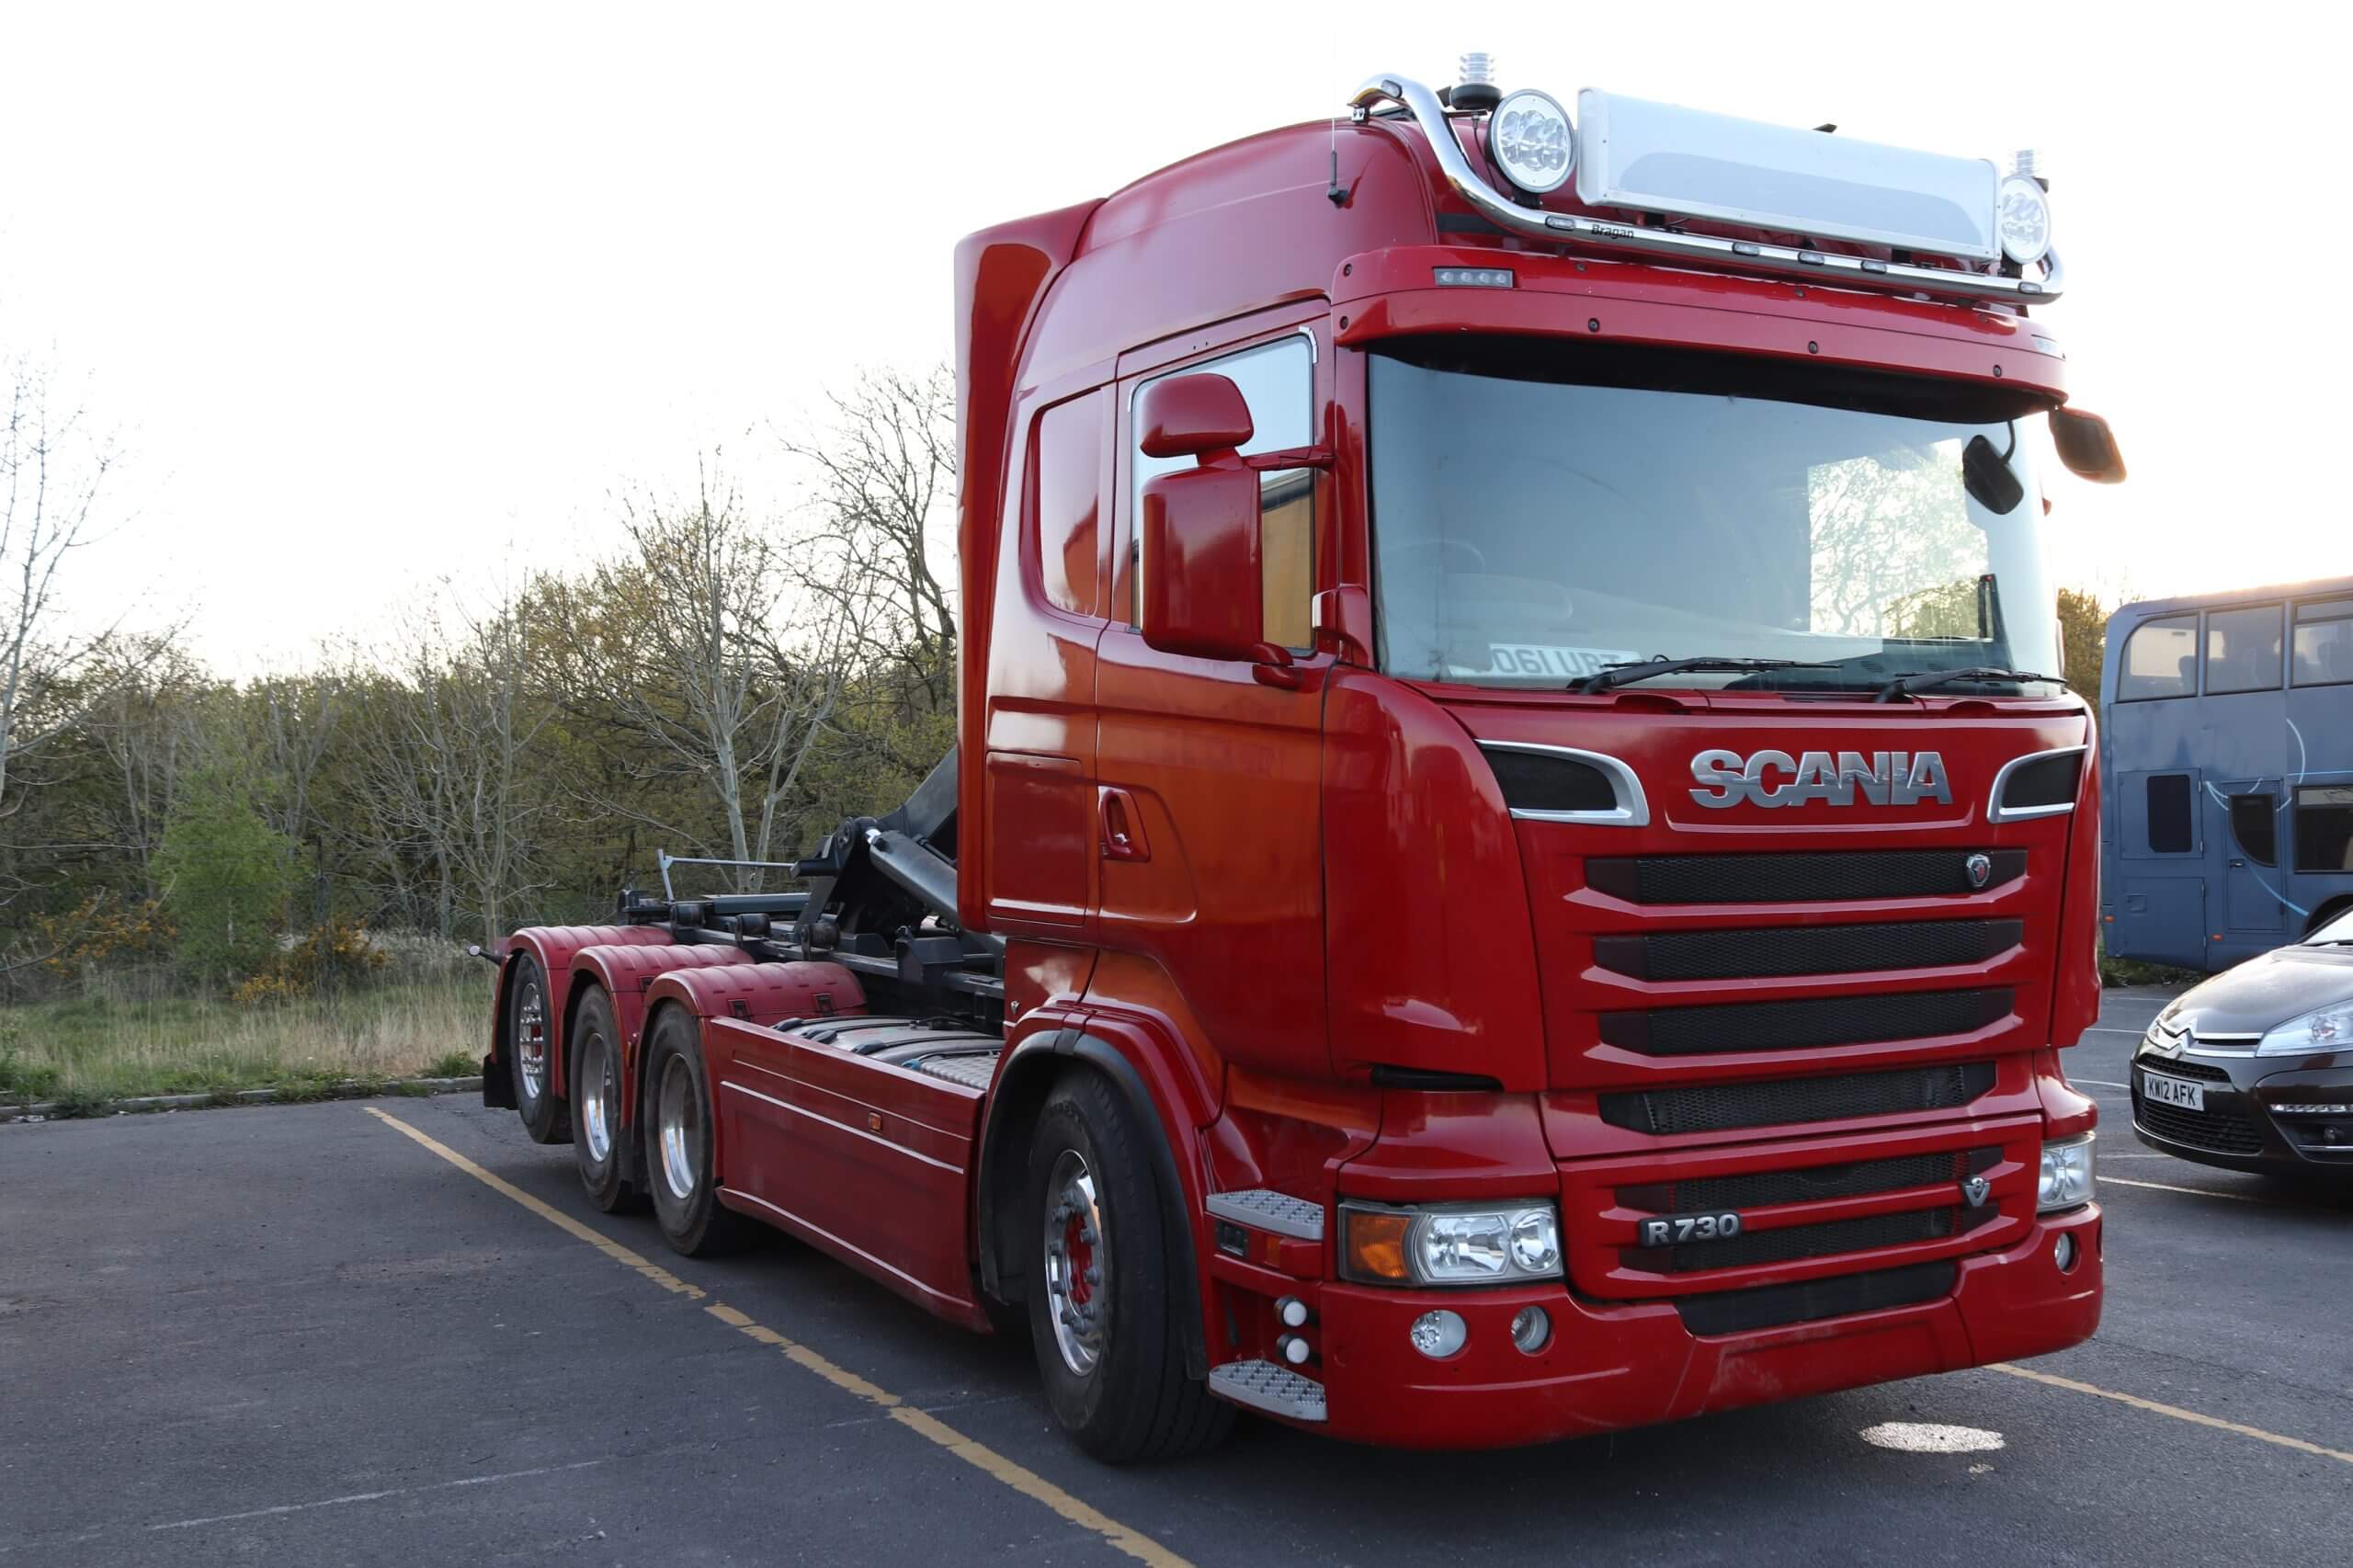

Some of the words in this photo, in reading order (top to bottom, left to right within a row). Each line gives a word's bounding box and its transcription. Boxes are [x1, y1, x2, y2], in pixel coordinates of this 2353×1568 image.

[1591, 223, 1635, 240] Bragan
[1688, 749, 1953, 809] SCANIA
[2148, 1076, 2170, 1100] KW12
[2173, 1083, 2196, 1106] AFK
[1647, 1221, 1669, 1244] R
[1675, 1213, 1739, 1242] 730
